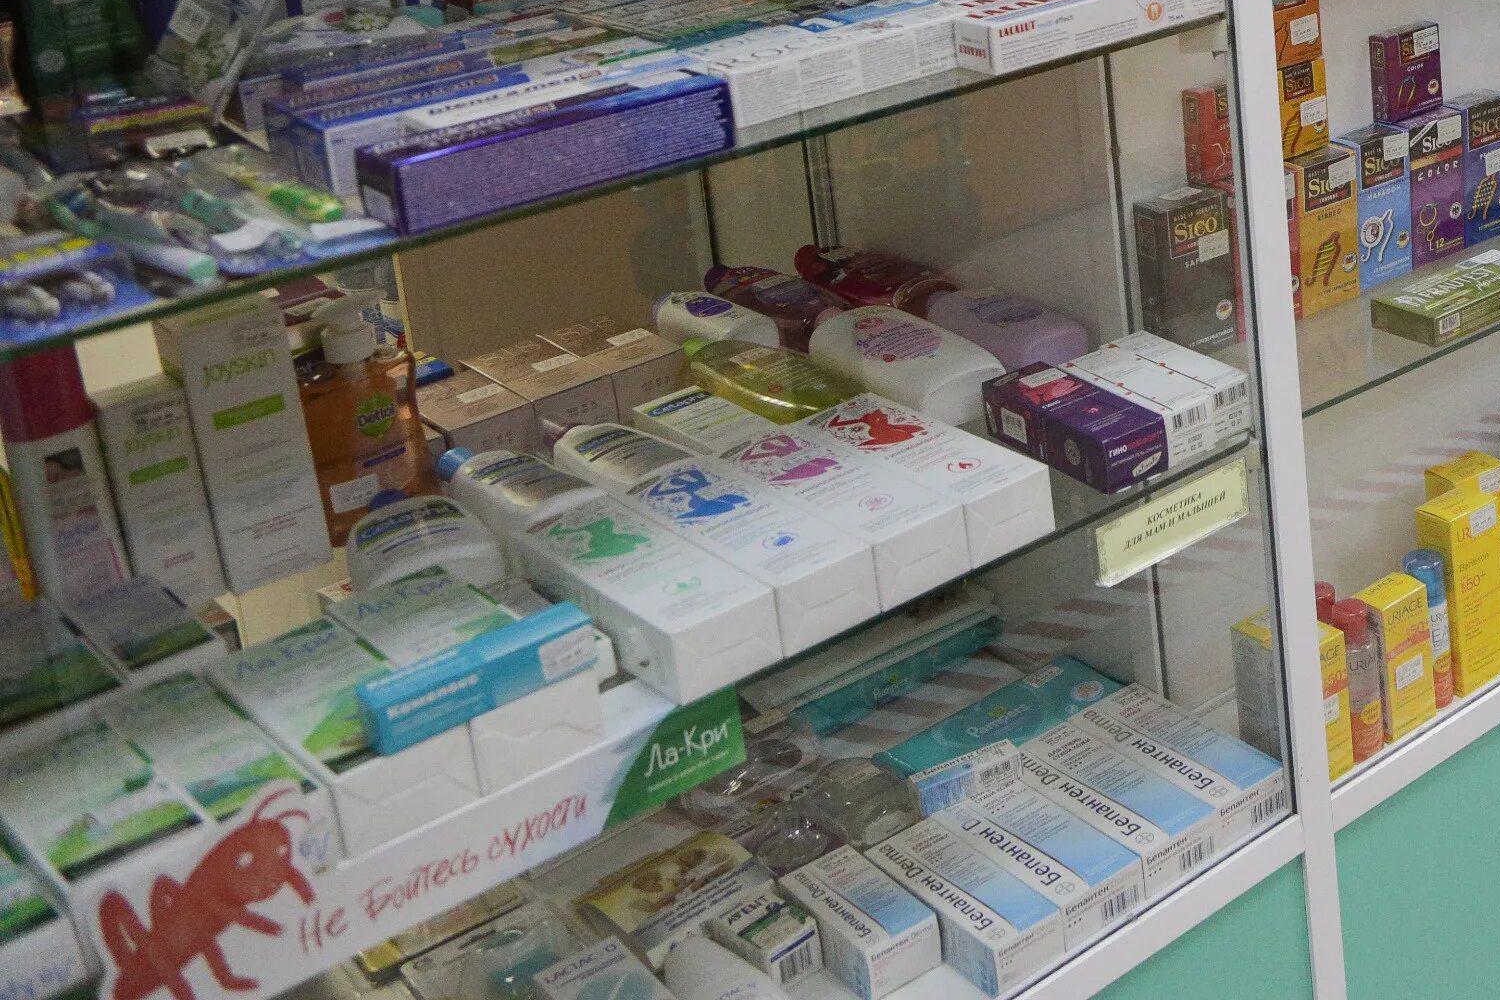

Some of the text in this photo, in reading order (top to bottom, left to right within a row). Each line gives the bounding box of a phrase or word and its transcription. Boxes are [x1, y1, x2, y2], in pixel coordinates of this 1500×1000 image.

[999, 14, 1074, 38] LACALUT effect
[1407, 62, 1425, 73] COLOR
[1285, 75, 1311, 94] SICO
[1417, 160, 1460, 183] COLOR
[1174, 216, 1218, 244] SICO
[1435, 237, 1446, 250] 12
[1418, 266, 1495, 299] FRAUTEST
[356, 404, 396, 429] Dettol
[1122, 532, 1143, 552] ДЛЯ
[1144, 521, 1167, 540] МАМ
[1177, 490, 1227, 522] МАЛЫШЕЙ
[1147, 490, 1203, 526] КОСМЕТИКА
[1388, 598, 1424, 626] URIAGE
[643, 721, 729, 778] Ла-Кри
[1083, 708, 1217, 791] Бепантен Derma
[1058, 782, 1143, 837] Бепантен
[1219, 789, 1261, 818] Бепантен
[980, 825, 1063, 886] Бепантен
[1145, 834, 1190, 865] Бепантен
[299, 791, 589, 957] Не Бойтесь сухости
[919, 873, 995, 932] Бепантен
[1064, 884, 1111, 917] Бепантен
[822, 899, 875, 945] Бепантен
[870, 934, 910, 962] Бепантен
